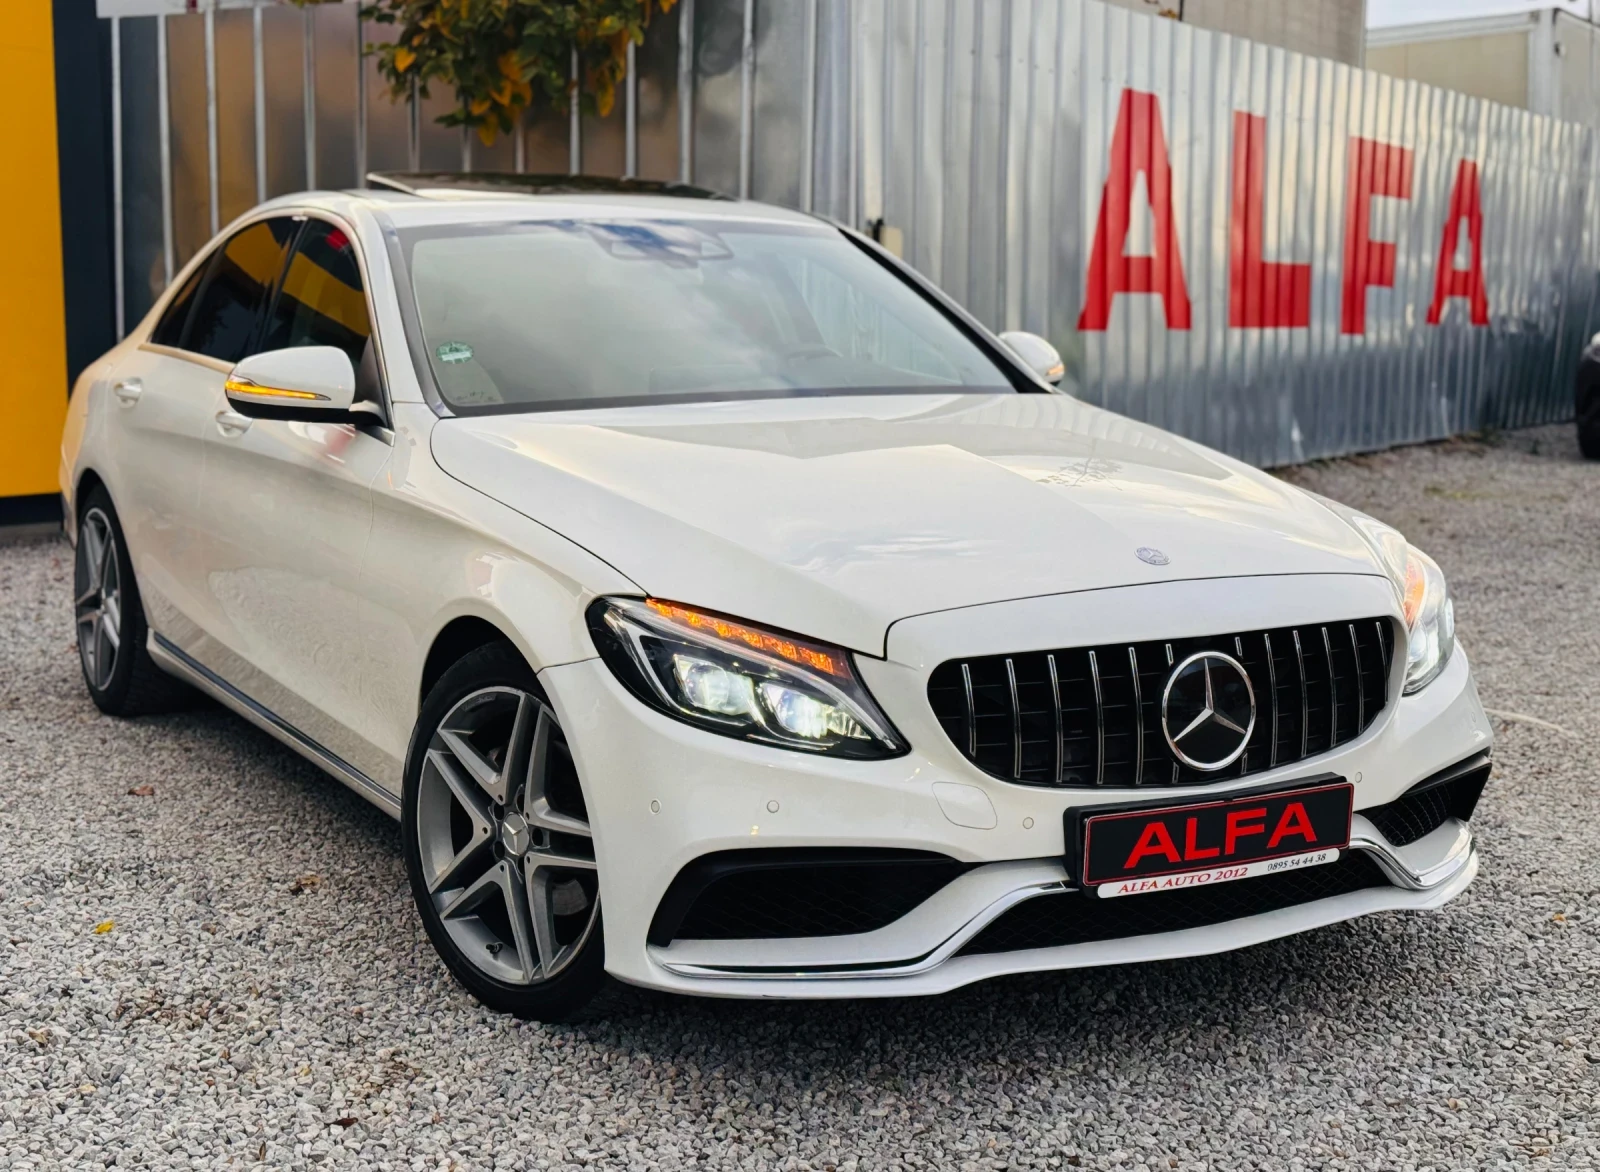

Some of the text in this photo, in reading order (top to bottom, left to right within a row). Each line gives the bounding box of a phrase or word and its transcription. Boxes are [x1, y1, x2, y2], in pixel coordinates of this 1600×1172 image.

[1077, 88, 1489, 335] ALFA
[1123, 802, 1318, 869] ALFA
[1118, 867, 1248, 893] ALFA AUTO 2012
[1267, 853, 1327, 872] 0895 54 44 38
